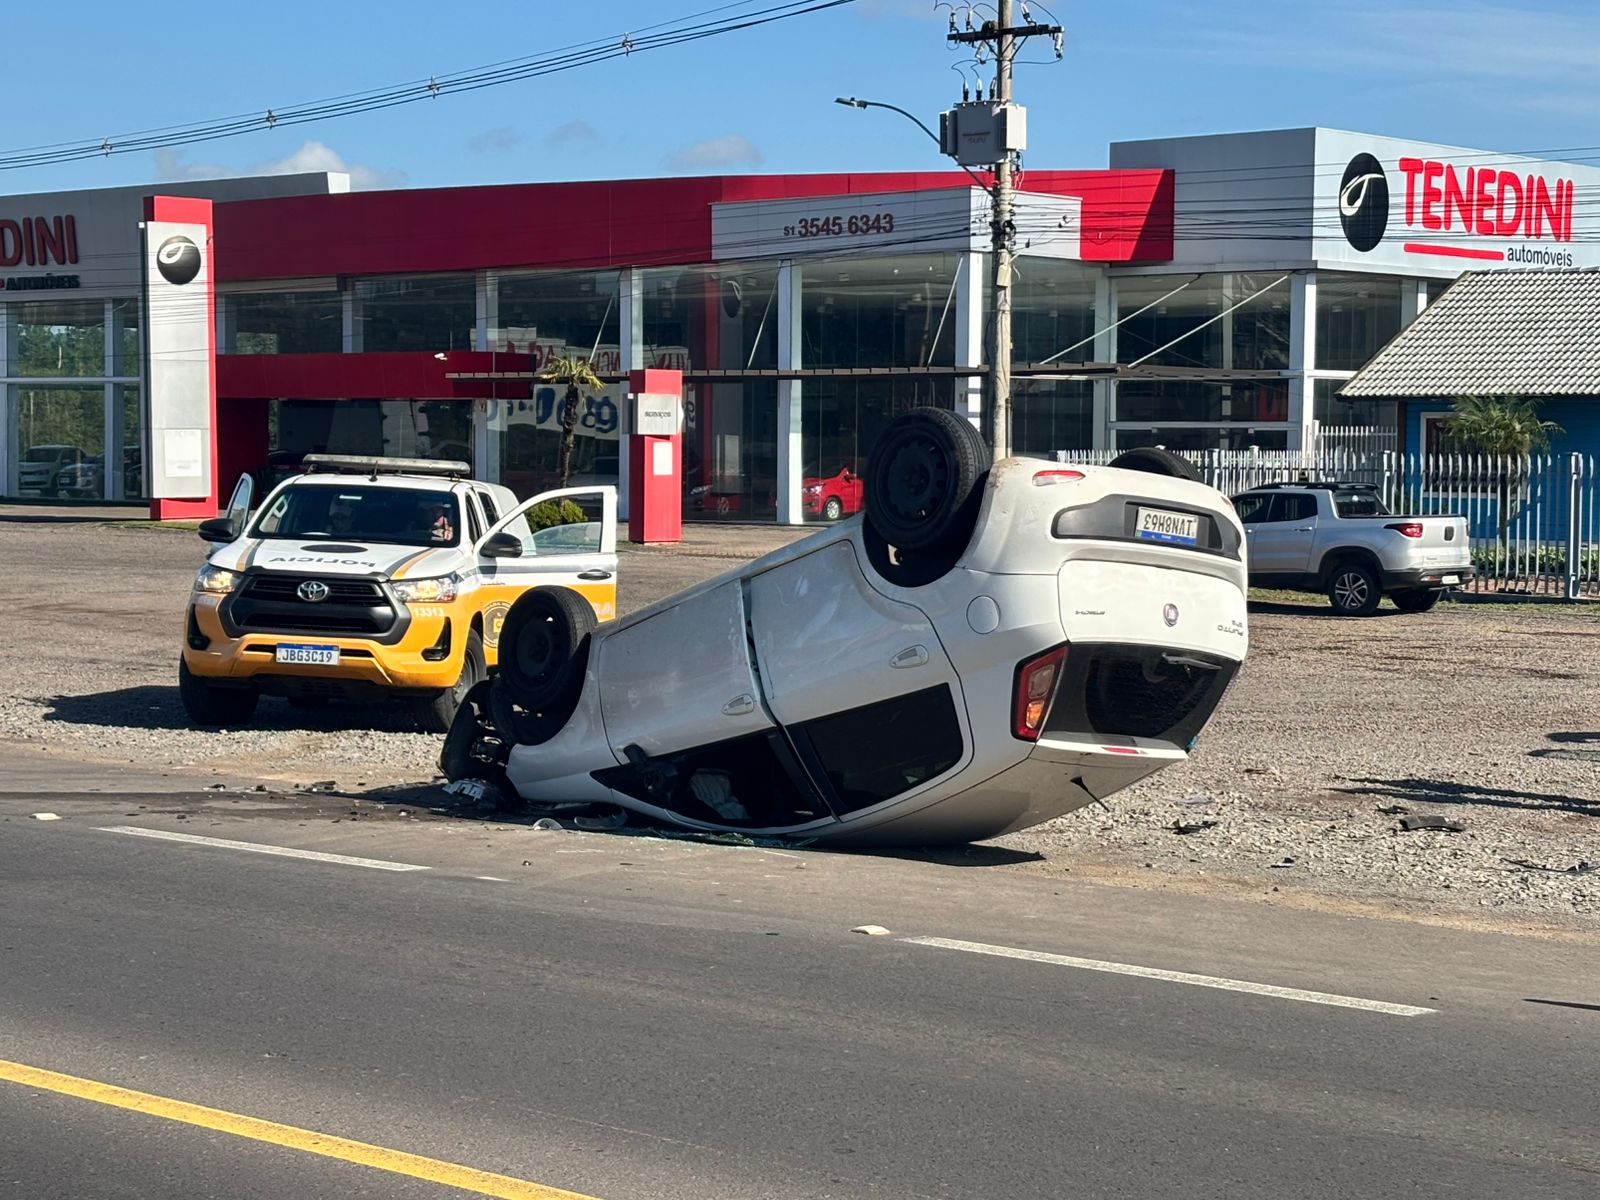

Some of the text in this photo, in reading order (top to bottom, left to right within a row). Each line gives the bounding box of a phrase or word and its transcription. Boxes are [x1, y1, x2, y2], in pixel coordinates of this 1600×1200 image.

[1399, 157, 1574, 242] TENEDINI
[783, 213, 894, 237] 51 3545 6343
[1507, 244, 1573, 267] automóveis
[1143, 513, 1193, 536] IVN8H63
[413, 607, 444, 617] 13313
[282, 649, 333, 663] JBG3C19
